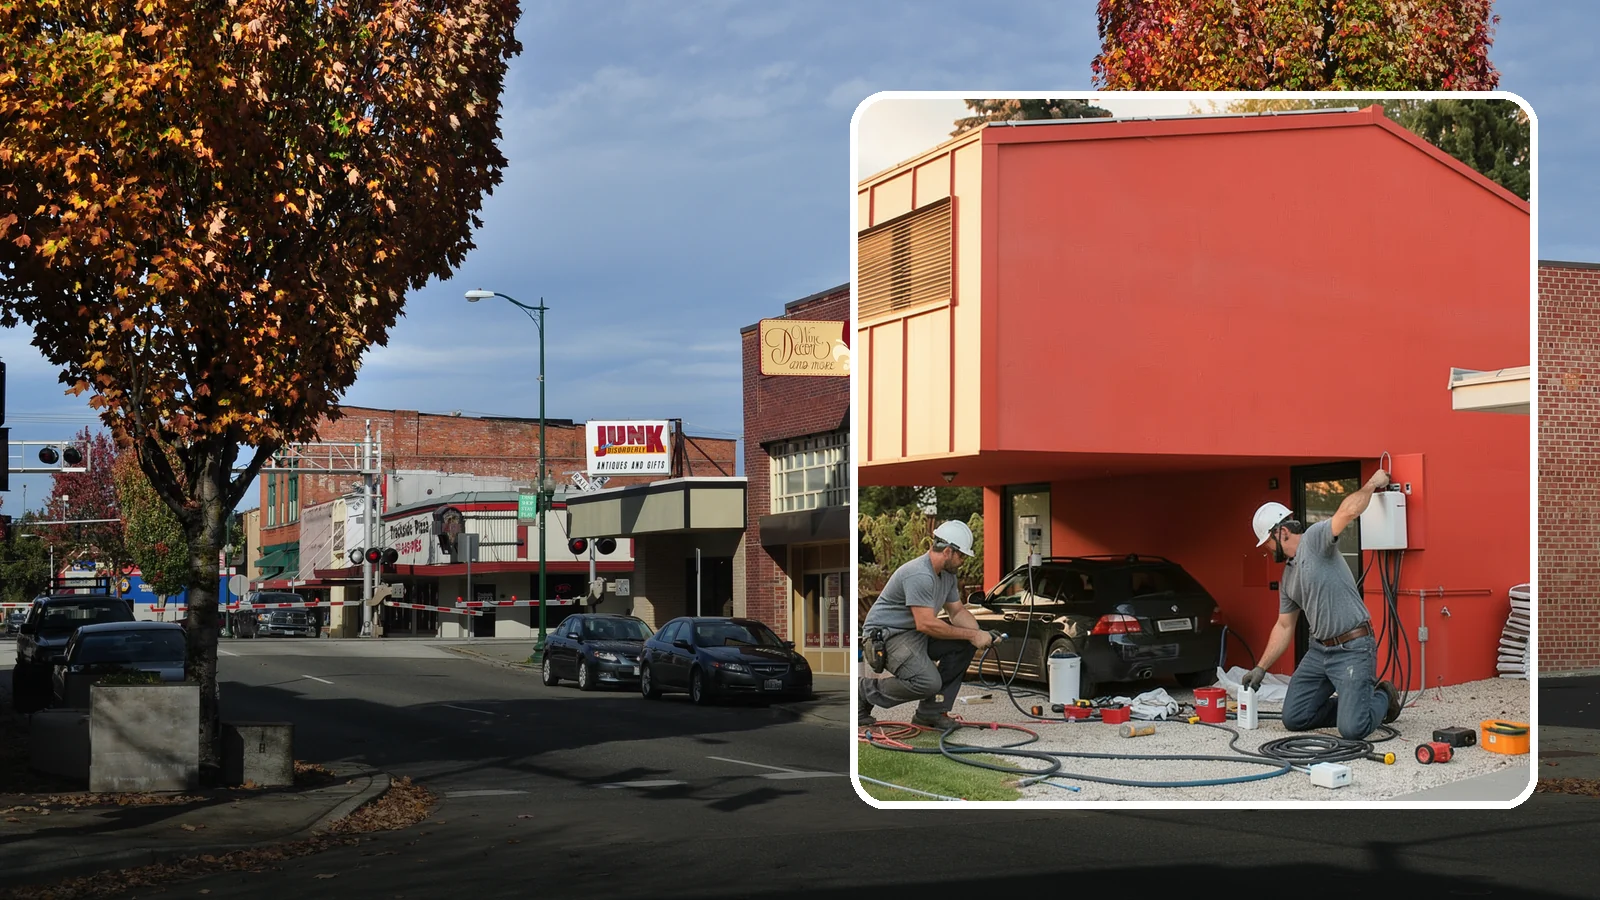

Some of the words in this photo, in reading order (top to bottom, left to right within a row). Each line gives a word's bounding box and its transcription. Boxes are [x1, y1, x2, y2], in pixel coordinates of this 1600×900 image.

[765, 327, 831, 365] Decor
[595, 425, 665, 457] JUNK
[607, 446, 646, 454] DISORDERLY
[597, 461, 628, 470] ANTIQUES
[631, 461, 644, 470] AND
[647, 460, 665, 469] GIFTS
[390, 521, 413, 539] Trackside
[415, 519, 429, 535] Pizza
